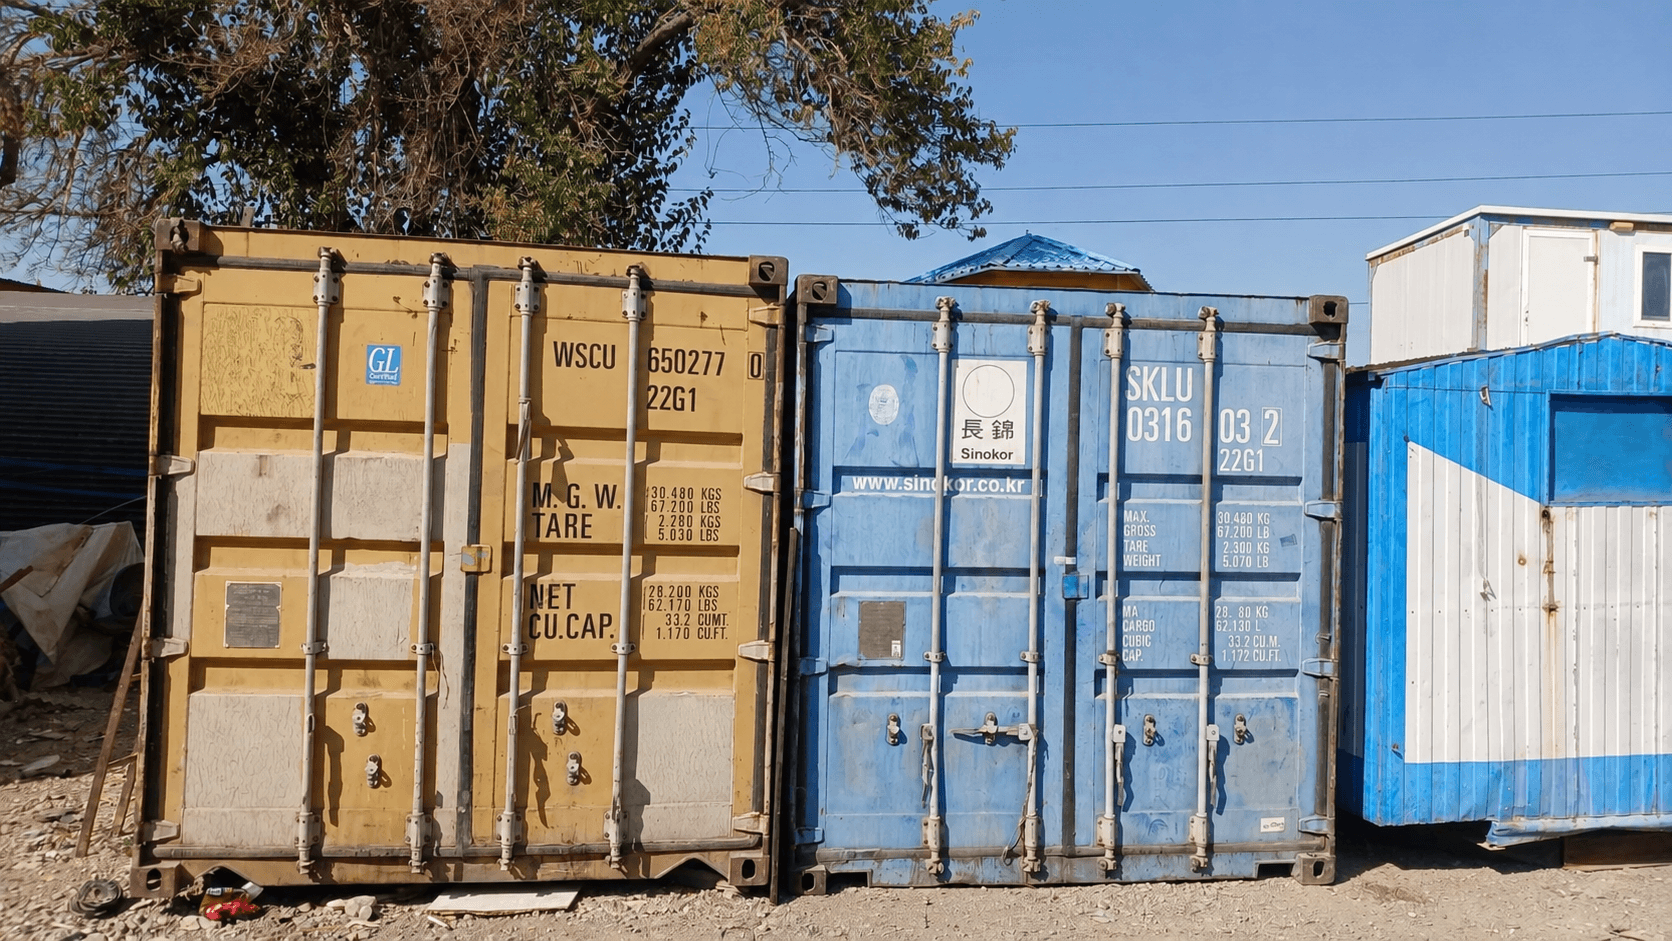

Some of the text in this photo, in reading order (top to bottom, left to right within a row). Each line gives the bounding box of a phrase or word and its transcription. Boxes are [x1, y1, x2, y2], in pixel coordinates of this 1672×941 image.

[368, 347, 399, 373] GL
[553, 341, 762, 378] WSCU 650277 0
[1126, 365, 1193, 402] SKLU
[646, 385, 696, 412] 22G1
[1127, 407, 1279, 444] 0316 03 2
[961, 448, 1014, 460] Sinokor
[1219, 448, 1263, 472] 22G1
[532, 482, 621, 509] M. G. W.
[651, 486, 722, 501] 30.480 KGS
[651, 500, 720, 514] 67.200 LBS
[659, 515, 721, 529] 2.280 KGS
[1124, 510, 1150, 523] MAX.
[1217, 511, 1270, 525] 30.480 KG
[532, 513, 593, 539] TARE
[1124, 525, 1156, 537] GROSS
[1217, 526, 1270, 539] 67.200 LB
[658, 528, 719, 542] 5.030 LBS
[1124, 540, 1148, 552] TARE
[1223, 541, 1270, 554] 2.300 KG
[1123, 554, 1161, 567] WEIGHT
[1222, 555, 1269, 568] 5.070 LB
[530, 583, 576, 610] NET
[649, 585, 719, 598] 28.200 KGS
[648, 599, 717, 611] 62.170 LBS
[1256, 606, 1269, 618] KG
[665, 613, 690, 626] 33.2
[1122, 620, 1156, 632] CARGO
[1216, 620, 1251, 632] 62.130
[528, 613, 615, 640] CU.CAP.
[657, 627, 728, 640] 1.170 CU.FT.
[1122, 635, 1152, 647] CUBIC
[1228, 635, 1281, 648] 33.2 CU.M.
[1122, 649, 1144, 662] CAP.
[1222, 649, 1282, 662] 1.172 CU.FT.
